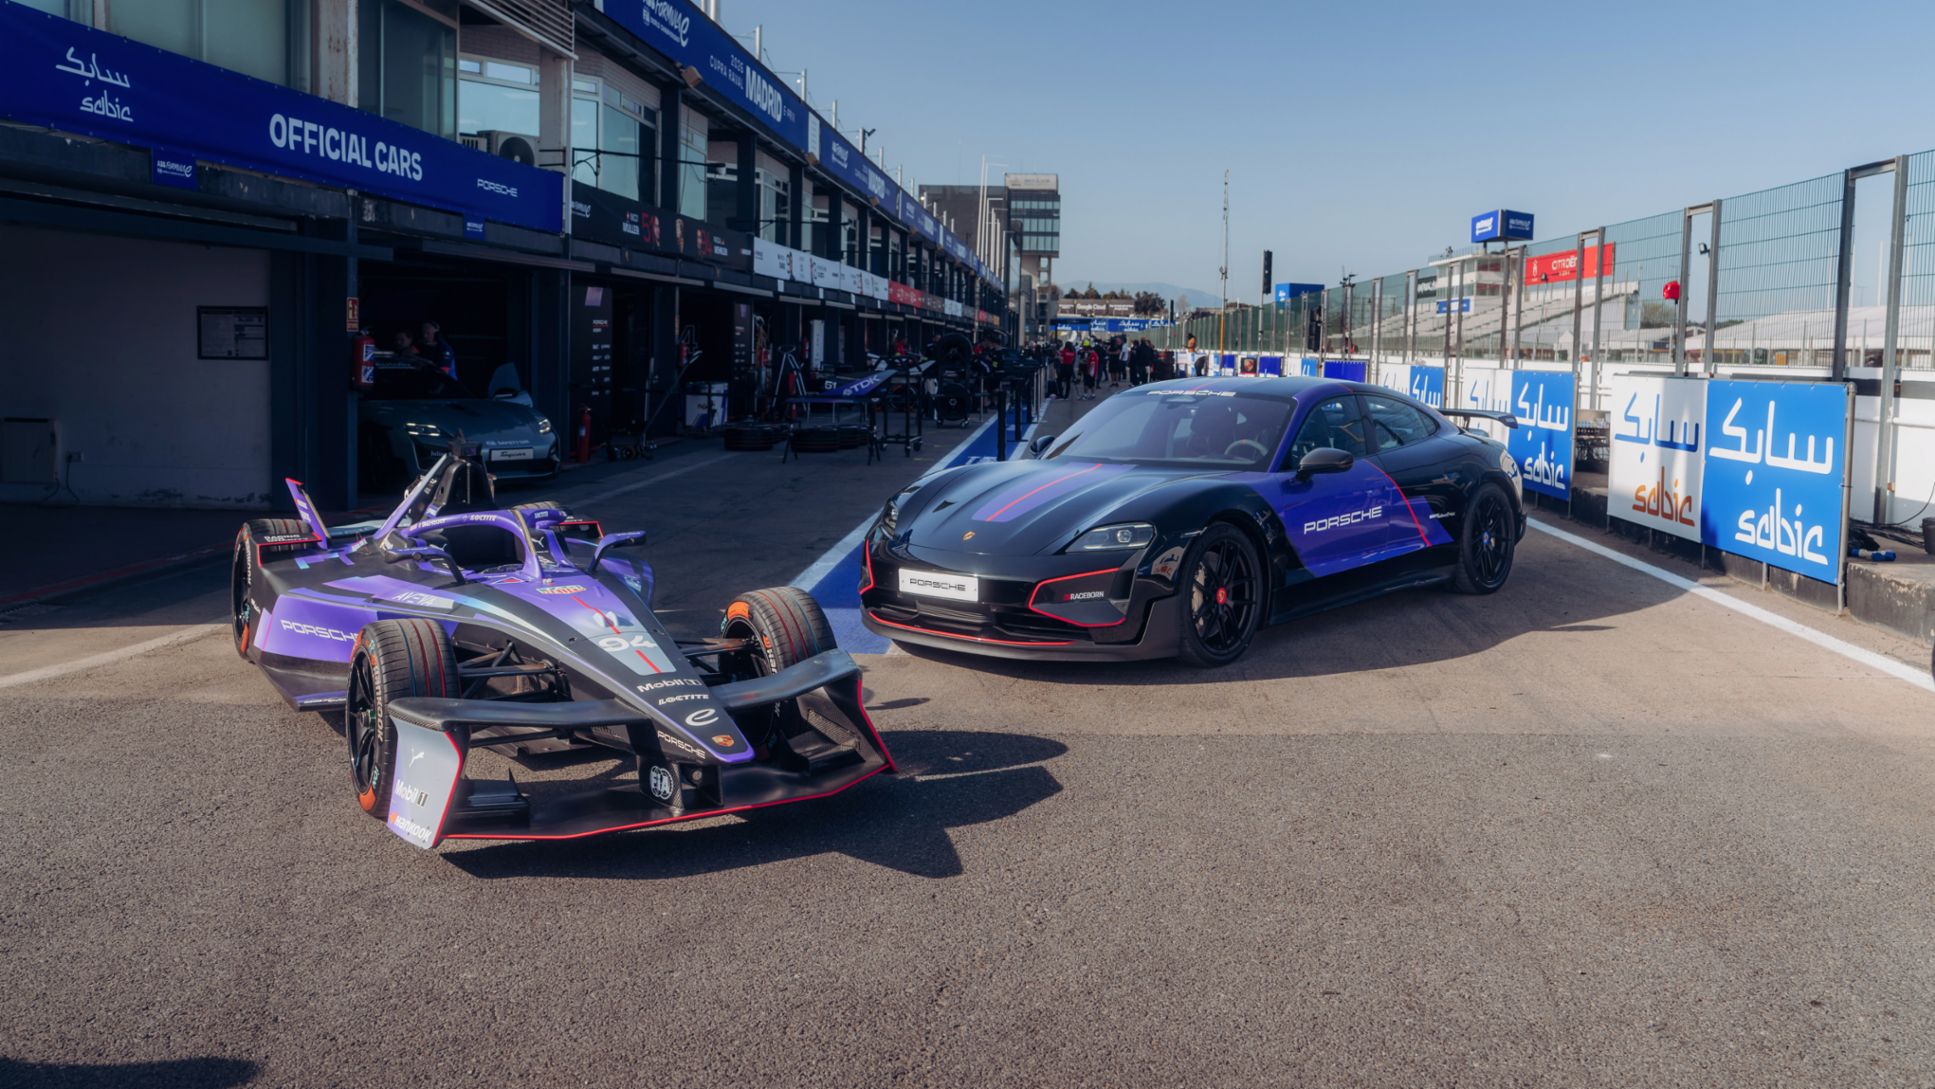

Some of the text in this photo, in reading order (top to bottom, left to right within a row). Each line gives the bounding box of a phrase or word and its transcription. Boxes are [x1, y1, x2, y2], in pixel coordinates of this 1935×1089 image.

[80, 90, 134, 122] sabic
[745, 64, 782, 123] MADRID
[269, 113, 423, 181] OFFICIAL CARS
[477, 179, 518, 197] PORSCHE
[824, 380, 837, 390] 51
[850, 374, 880, 392] TDK
[1614, 391, 1700, 464] سابك
[1709, 397, 1834, 485] سابك
[1523, 441, 1566, 490] sabic
[1632, 465, 1695, 527] sabic
[1304, 505, 1382, 535] PORSCHE
[1735, 487, 1828, 565] sabic
[909, 578, 966, 591] PORSCHE
[1070, 591, 1104, 600] RACEBORN
[599, 635, 657, 652] 94
[637, 679, 684, 692] Mobil
[658, 694, 709, 706] LOCTITE
[657, 730, 706, 760] PORSCHE
